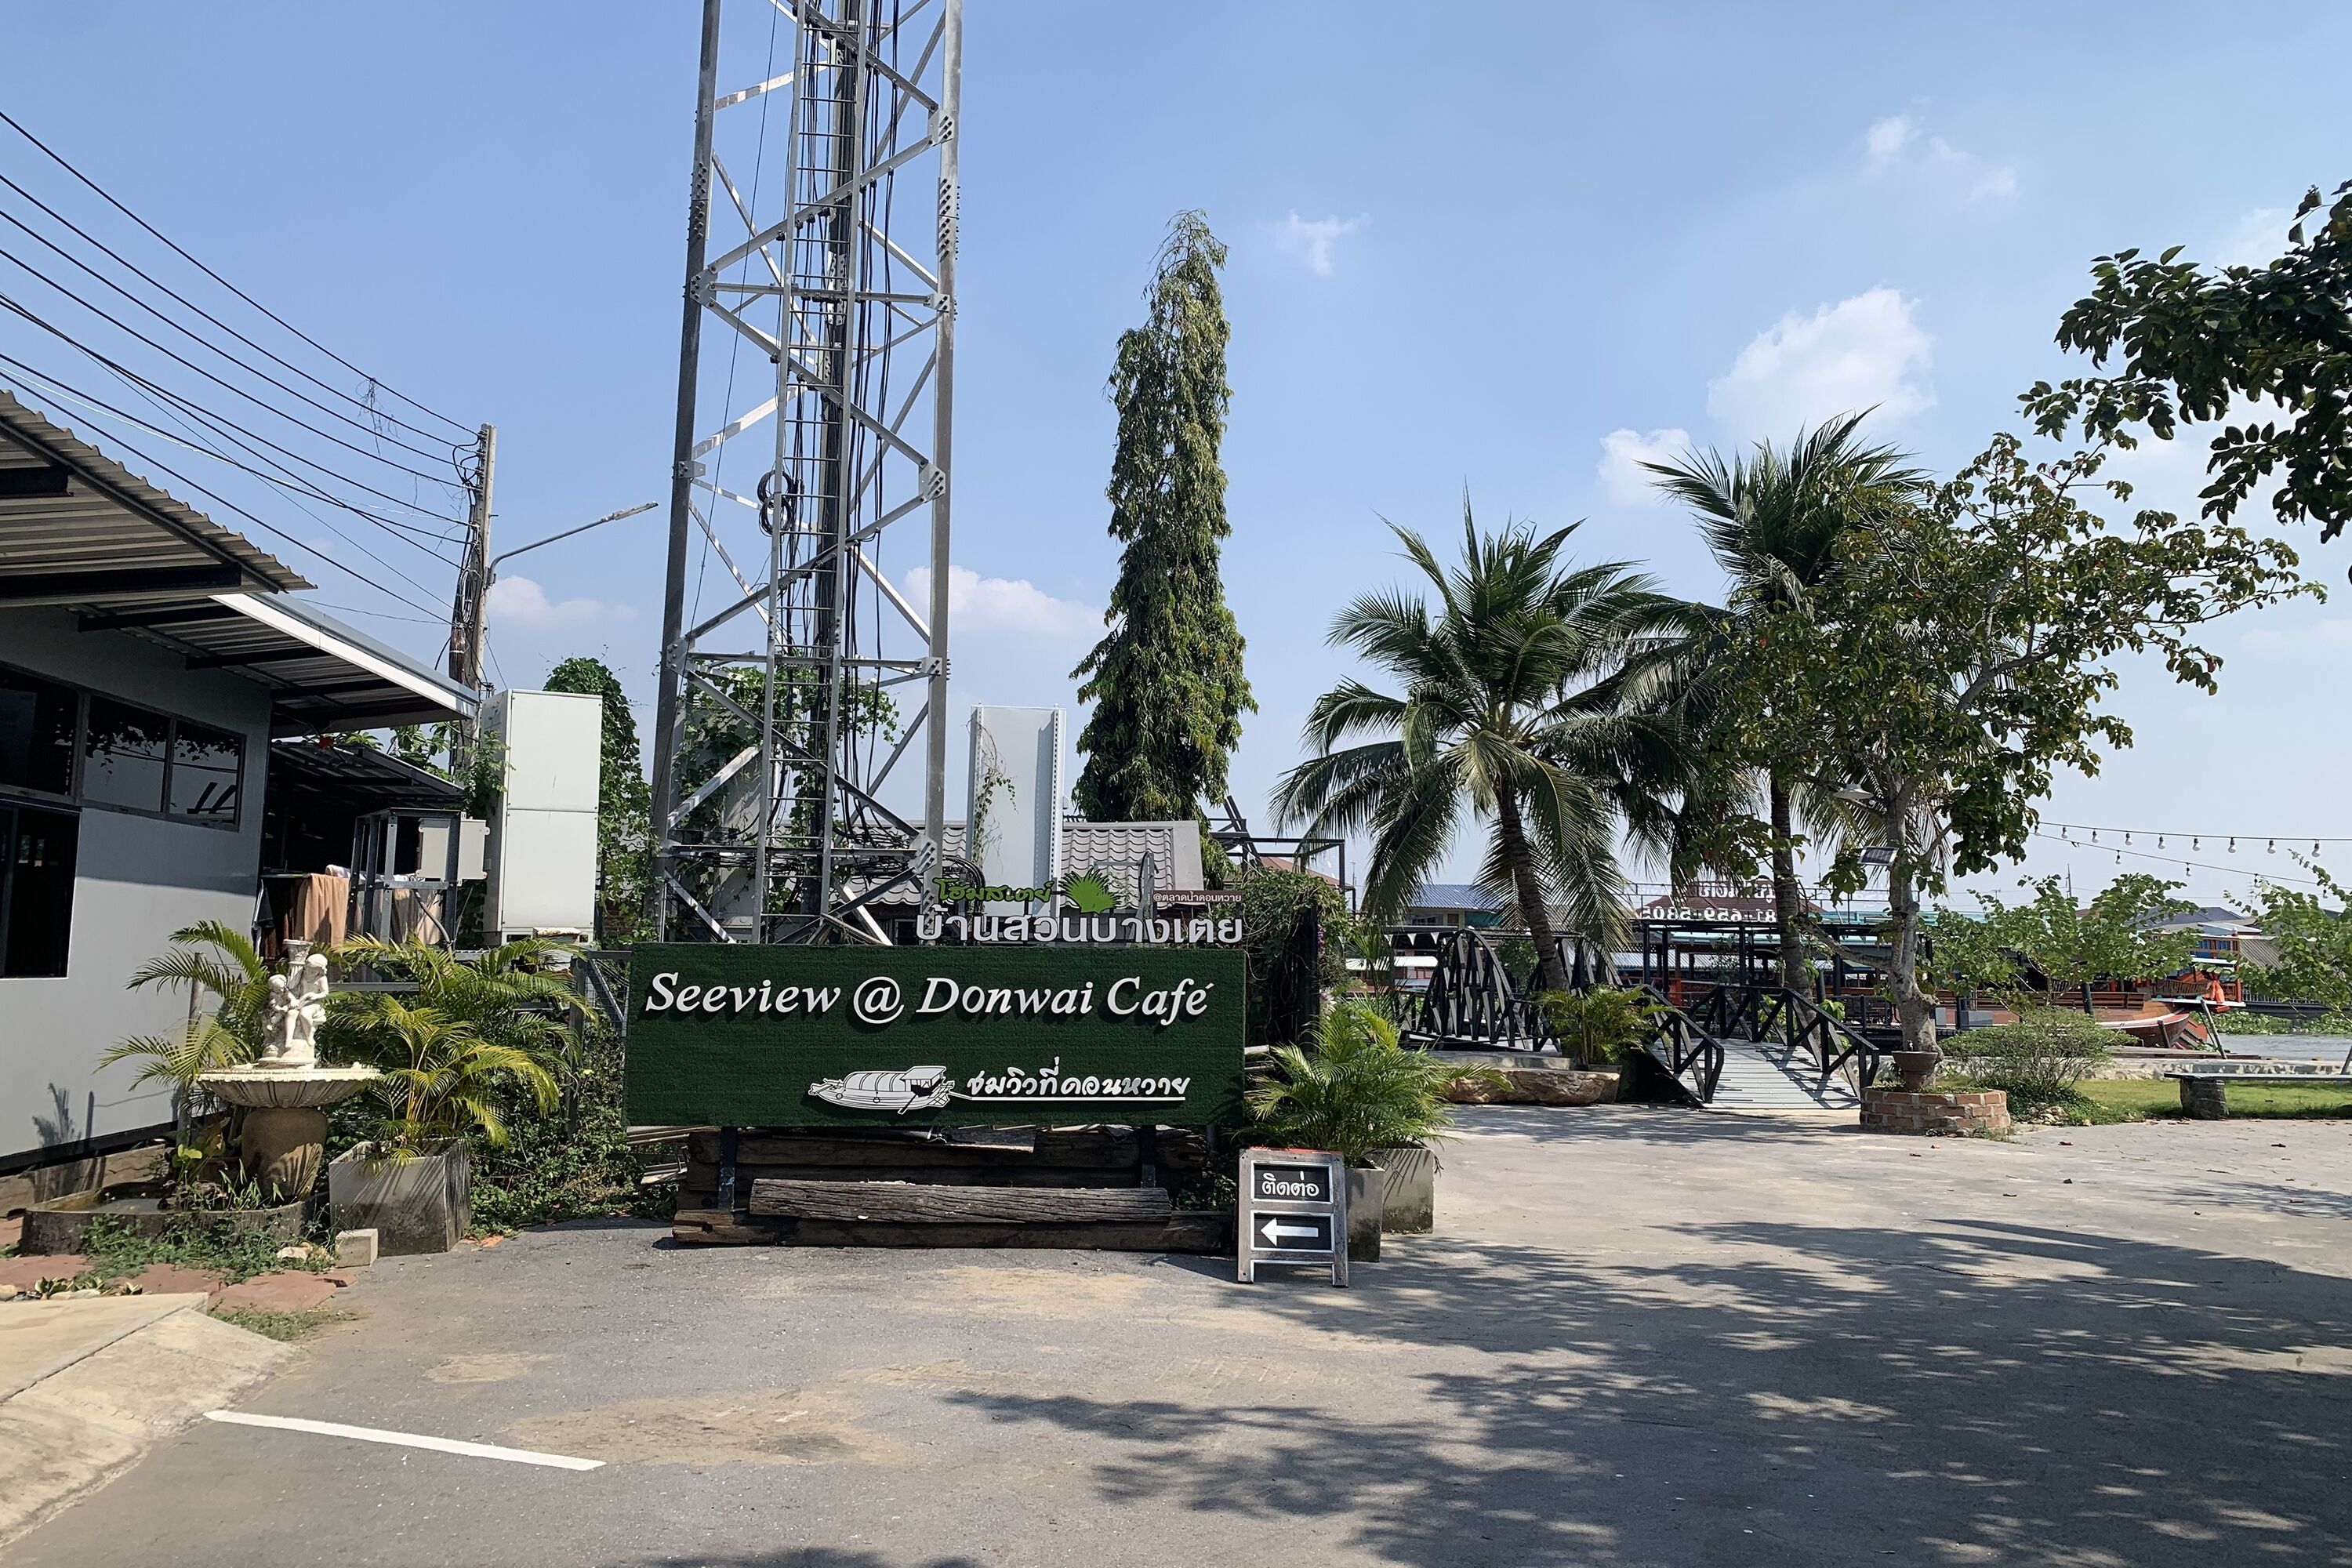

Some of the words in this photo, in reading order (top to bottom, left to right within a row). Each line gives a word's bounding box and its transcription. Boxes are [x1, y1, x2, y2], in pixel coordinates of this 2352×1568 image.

[932, 877, 1054, 902] โฮมสเตย์
[916, 904, 1243, 943] บ้านสวนบางเตย
[645, 971, 841, 1014] Seeview
[852, 976, 906, 1025] @
[916, 976, 1094, 1014] Donwai
[1105, 975, 1215, 1026] Café
[966, 1056, 1191, 1096] ชมวิวที่ดอนหวาย
[1261, 1171, 1320, 1197] ติดต่อ
